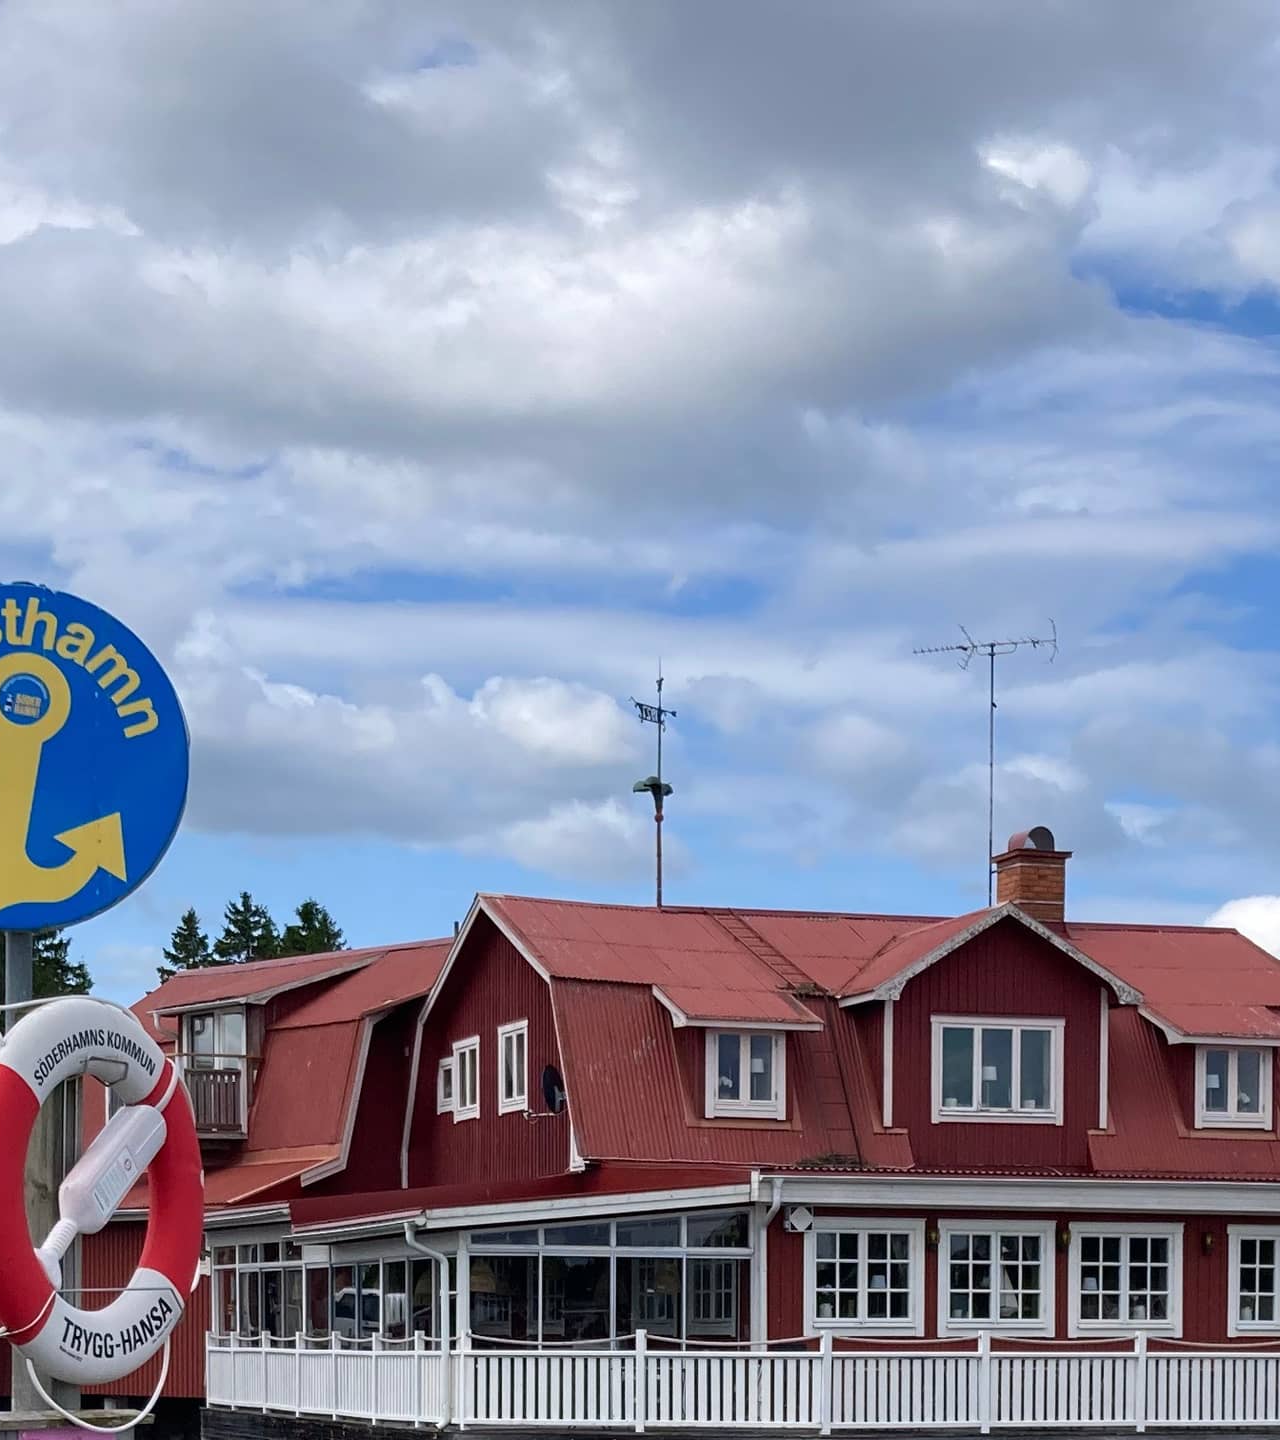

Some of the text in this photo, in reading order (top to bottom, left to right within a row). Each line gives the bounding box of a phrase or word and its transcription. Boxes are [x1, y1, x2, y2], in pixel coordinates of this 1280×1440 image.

[33, 1028, 157, 1087] SÖDERHAMNS KOMMUN
[60, 1296, 174, 1359] TRYGG-HANSA
